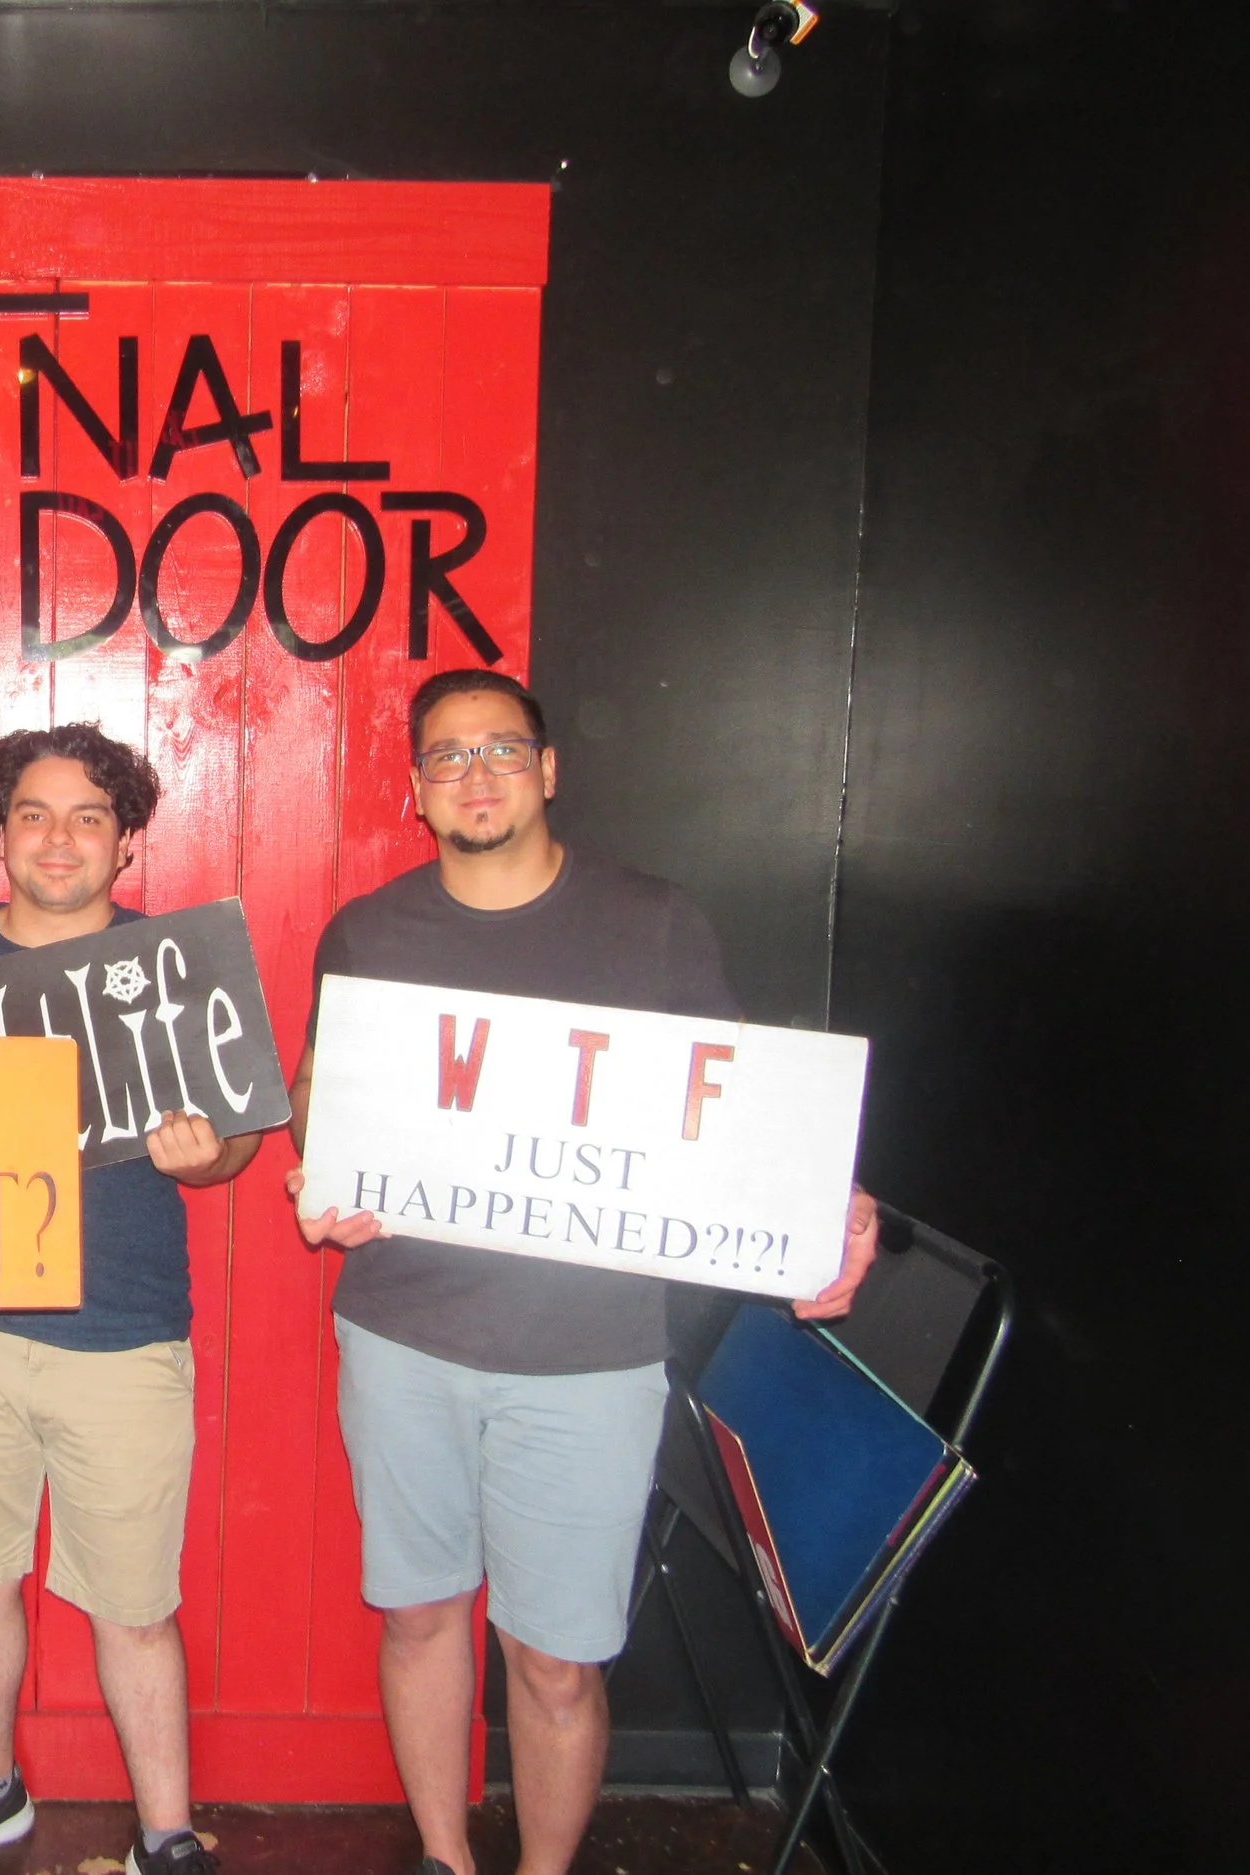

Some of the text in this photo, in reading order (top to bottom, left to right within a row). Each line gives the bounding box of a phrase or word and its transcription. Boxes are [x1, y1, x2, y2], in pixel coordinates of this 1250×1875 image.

[21, 491, 504, 666] DOOR
[64, 938, 253, 1143] Life
[352, 1170, 789, 1276] HAPPENED?!?!
[494, 1133, 646, 1191] JUST
